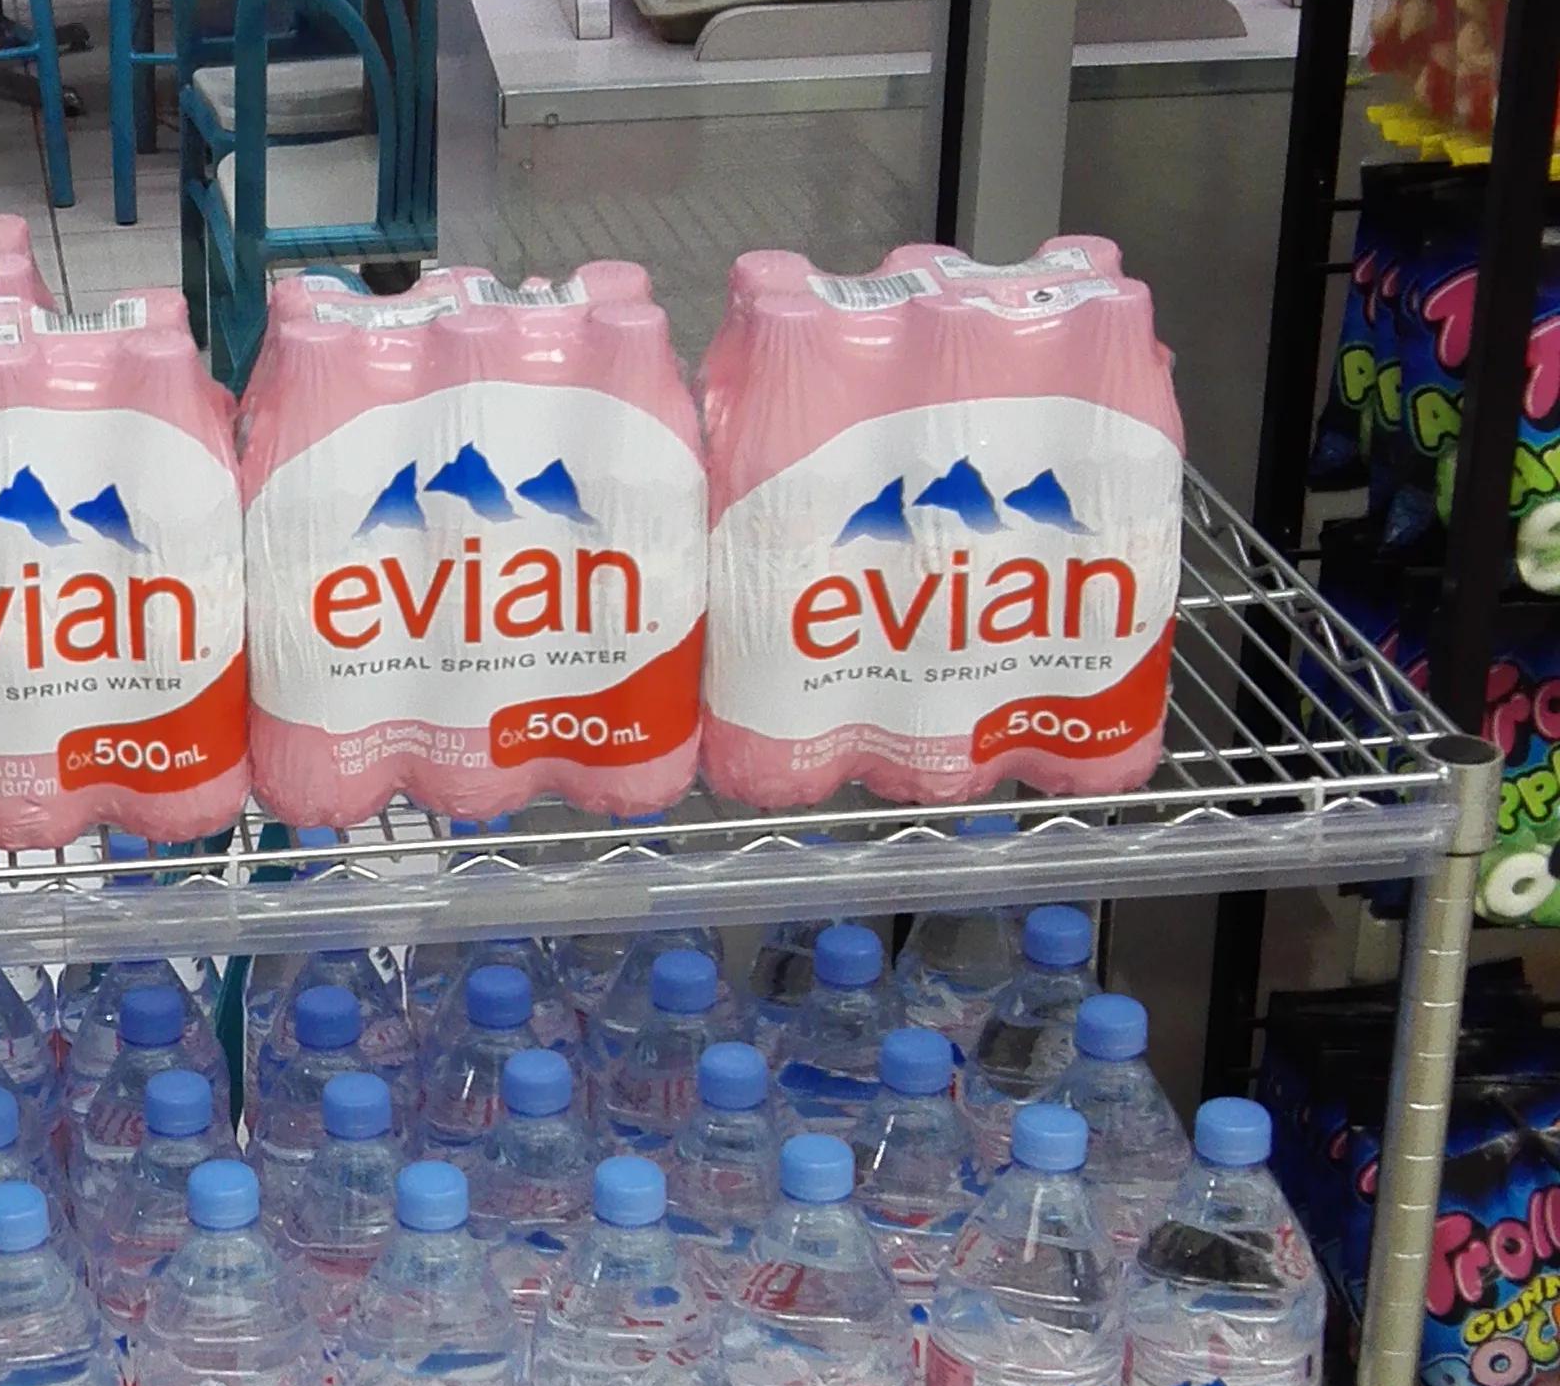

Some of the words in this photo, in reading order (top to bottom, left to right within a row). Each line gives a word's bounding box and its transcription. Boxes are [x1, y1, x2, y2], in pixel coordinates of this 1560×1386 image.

[313, 538, 643, 649] evian
[792, 550, 1137, 659] evian
[330, 656, 430, 677] NATURAL
[440, 653, 537, 672] SPRING
[546, 650, 627, 665] WATER
[803, 666, 913, 692] NATURAL
[924, 658, 1018, 683] SPRING
[1029, 654, 1113, 670] WATER
[6, 678, 98, 701] SPRING
[107, 677, 182, 691] WATER
